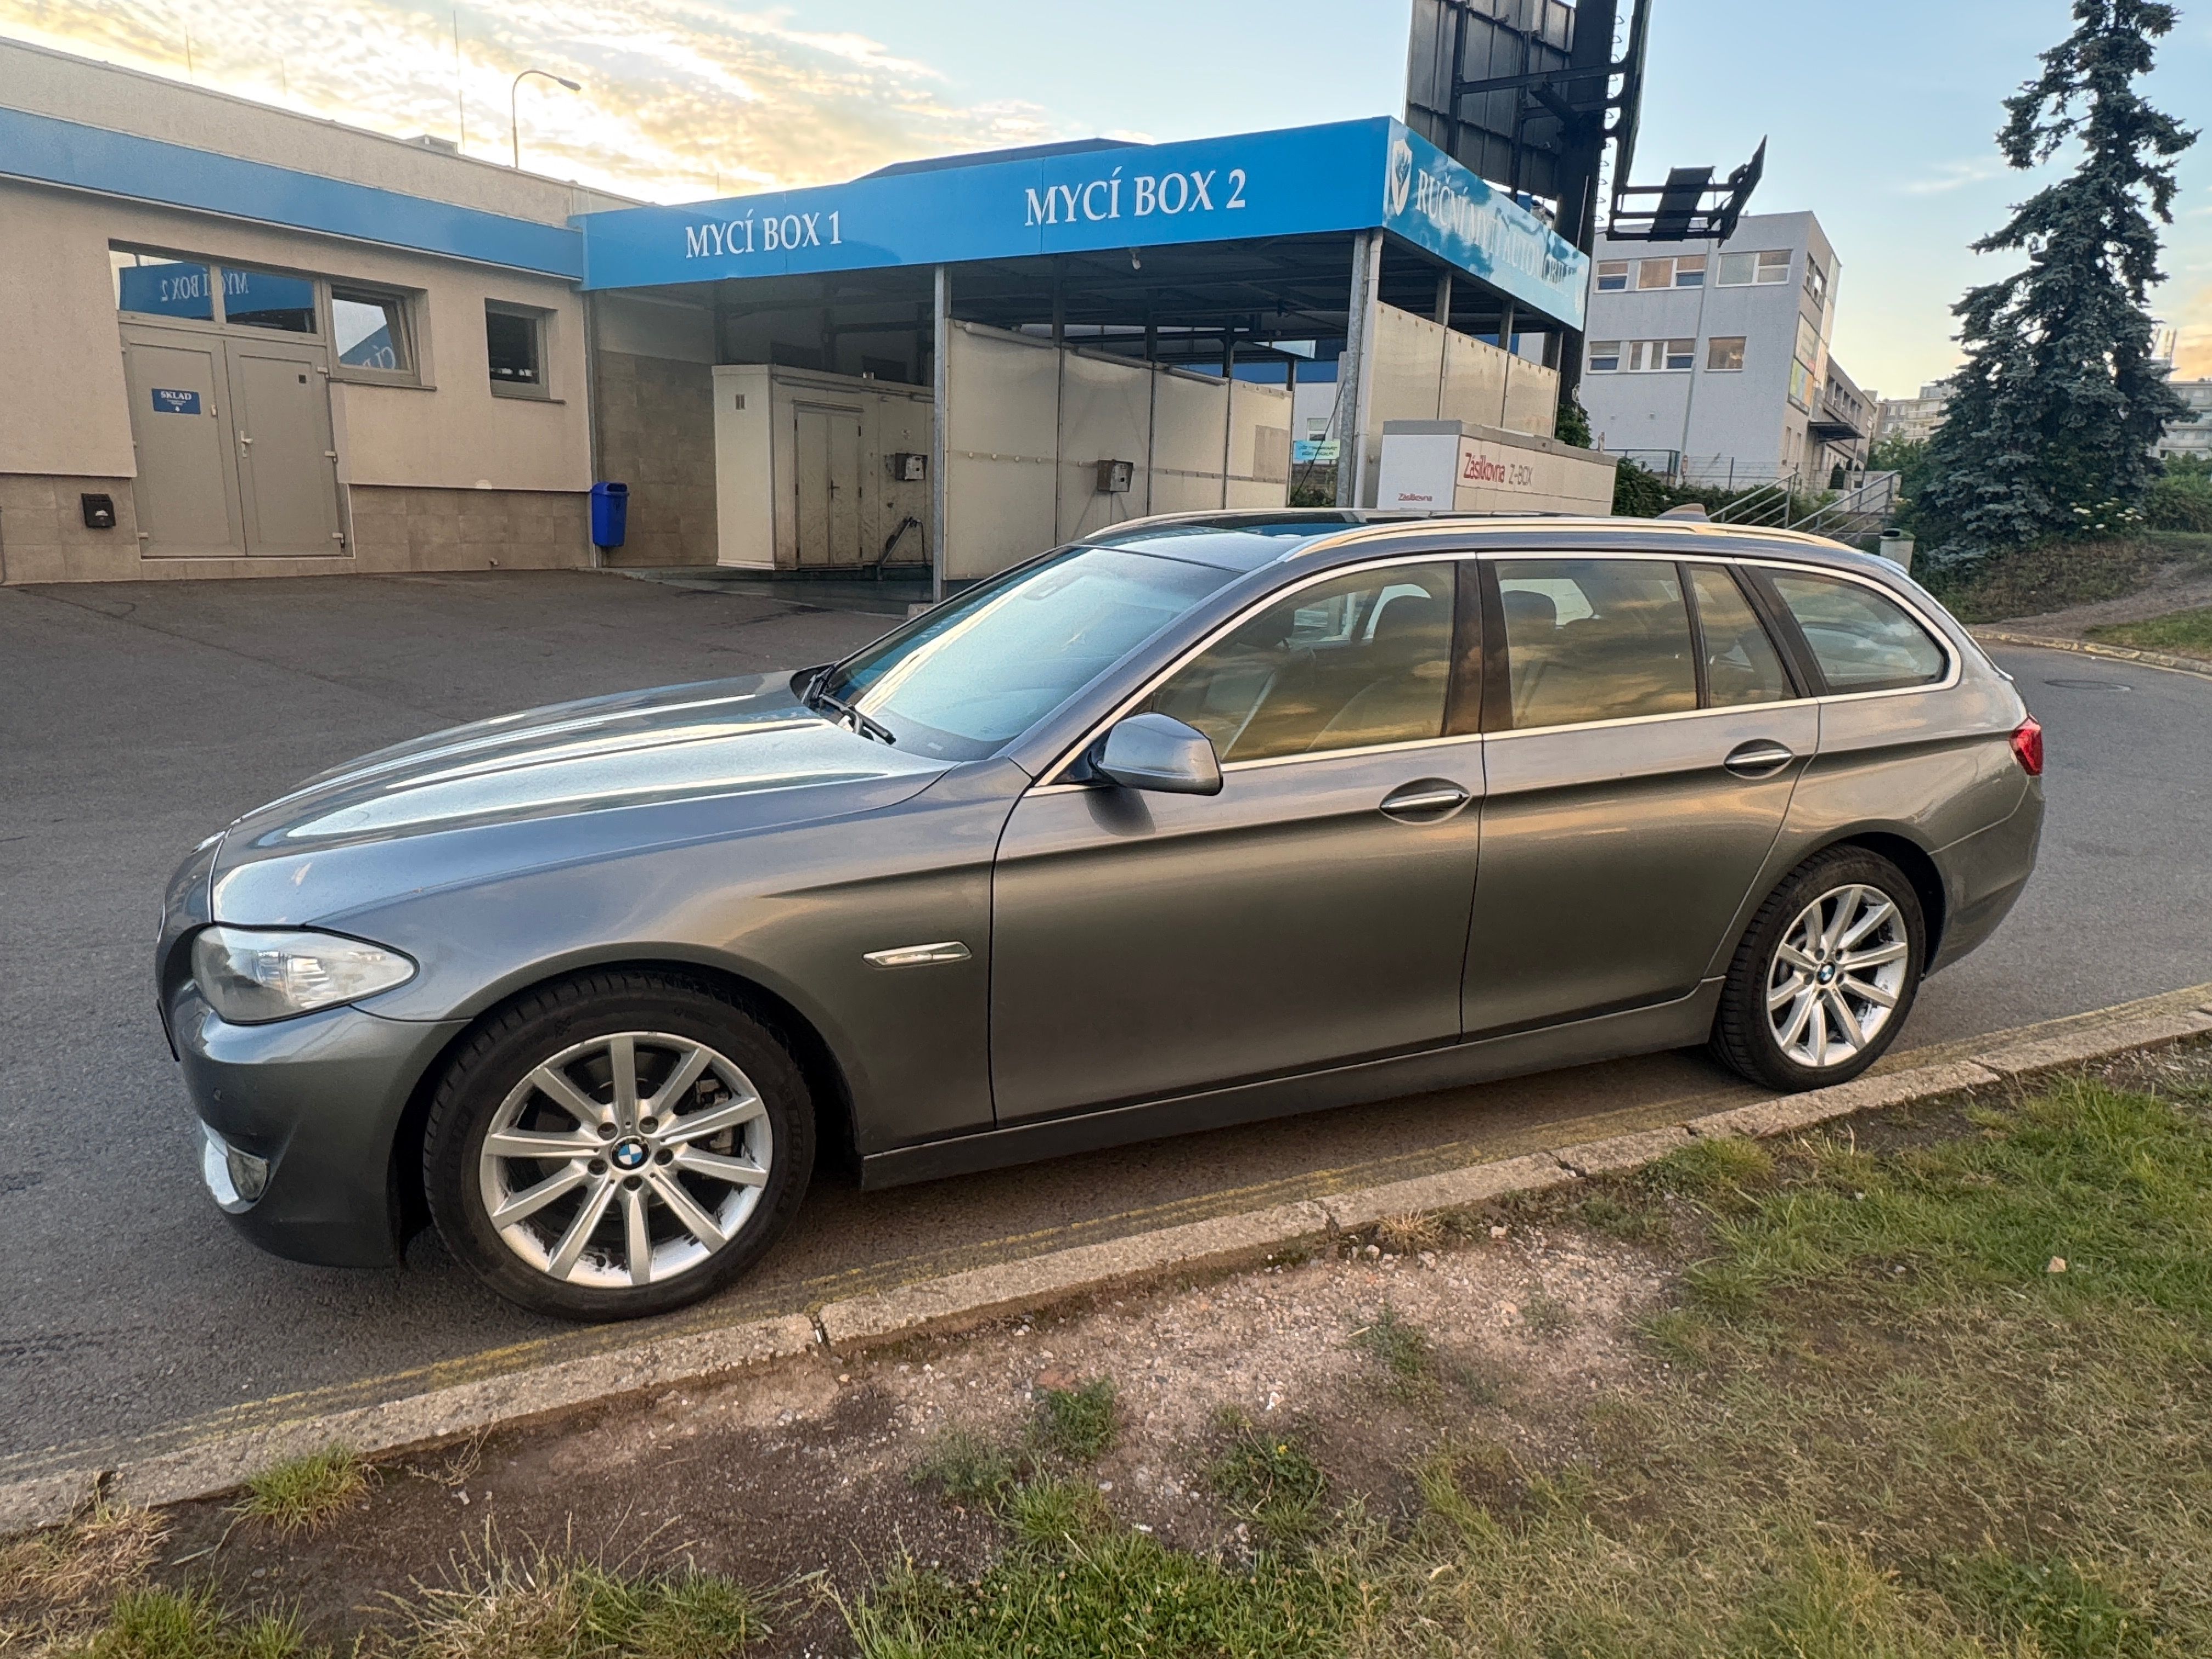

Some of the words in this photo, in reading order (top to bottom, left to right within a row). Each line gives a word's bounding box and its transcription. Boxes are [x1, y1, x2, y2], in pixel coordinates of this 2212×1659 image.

[1025, 166, 1122, 225] MYCÍ
[1133, 170, 1216, 216] BOX
[1226, 169, 1246, 209] 2
[1415, 168, 1470, 238] RUČNÍ
[685, 208, 755, 258] MYCÍ
[763, 212, 821, 251] BOX
[828, 211, 842, 245] 1
[160, 391, 192, 400] SKLAD
